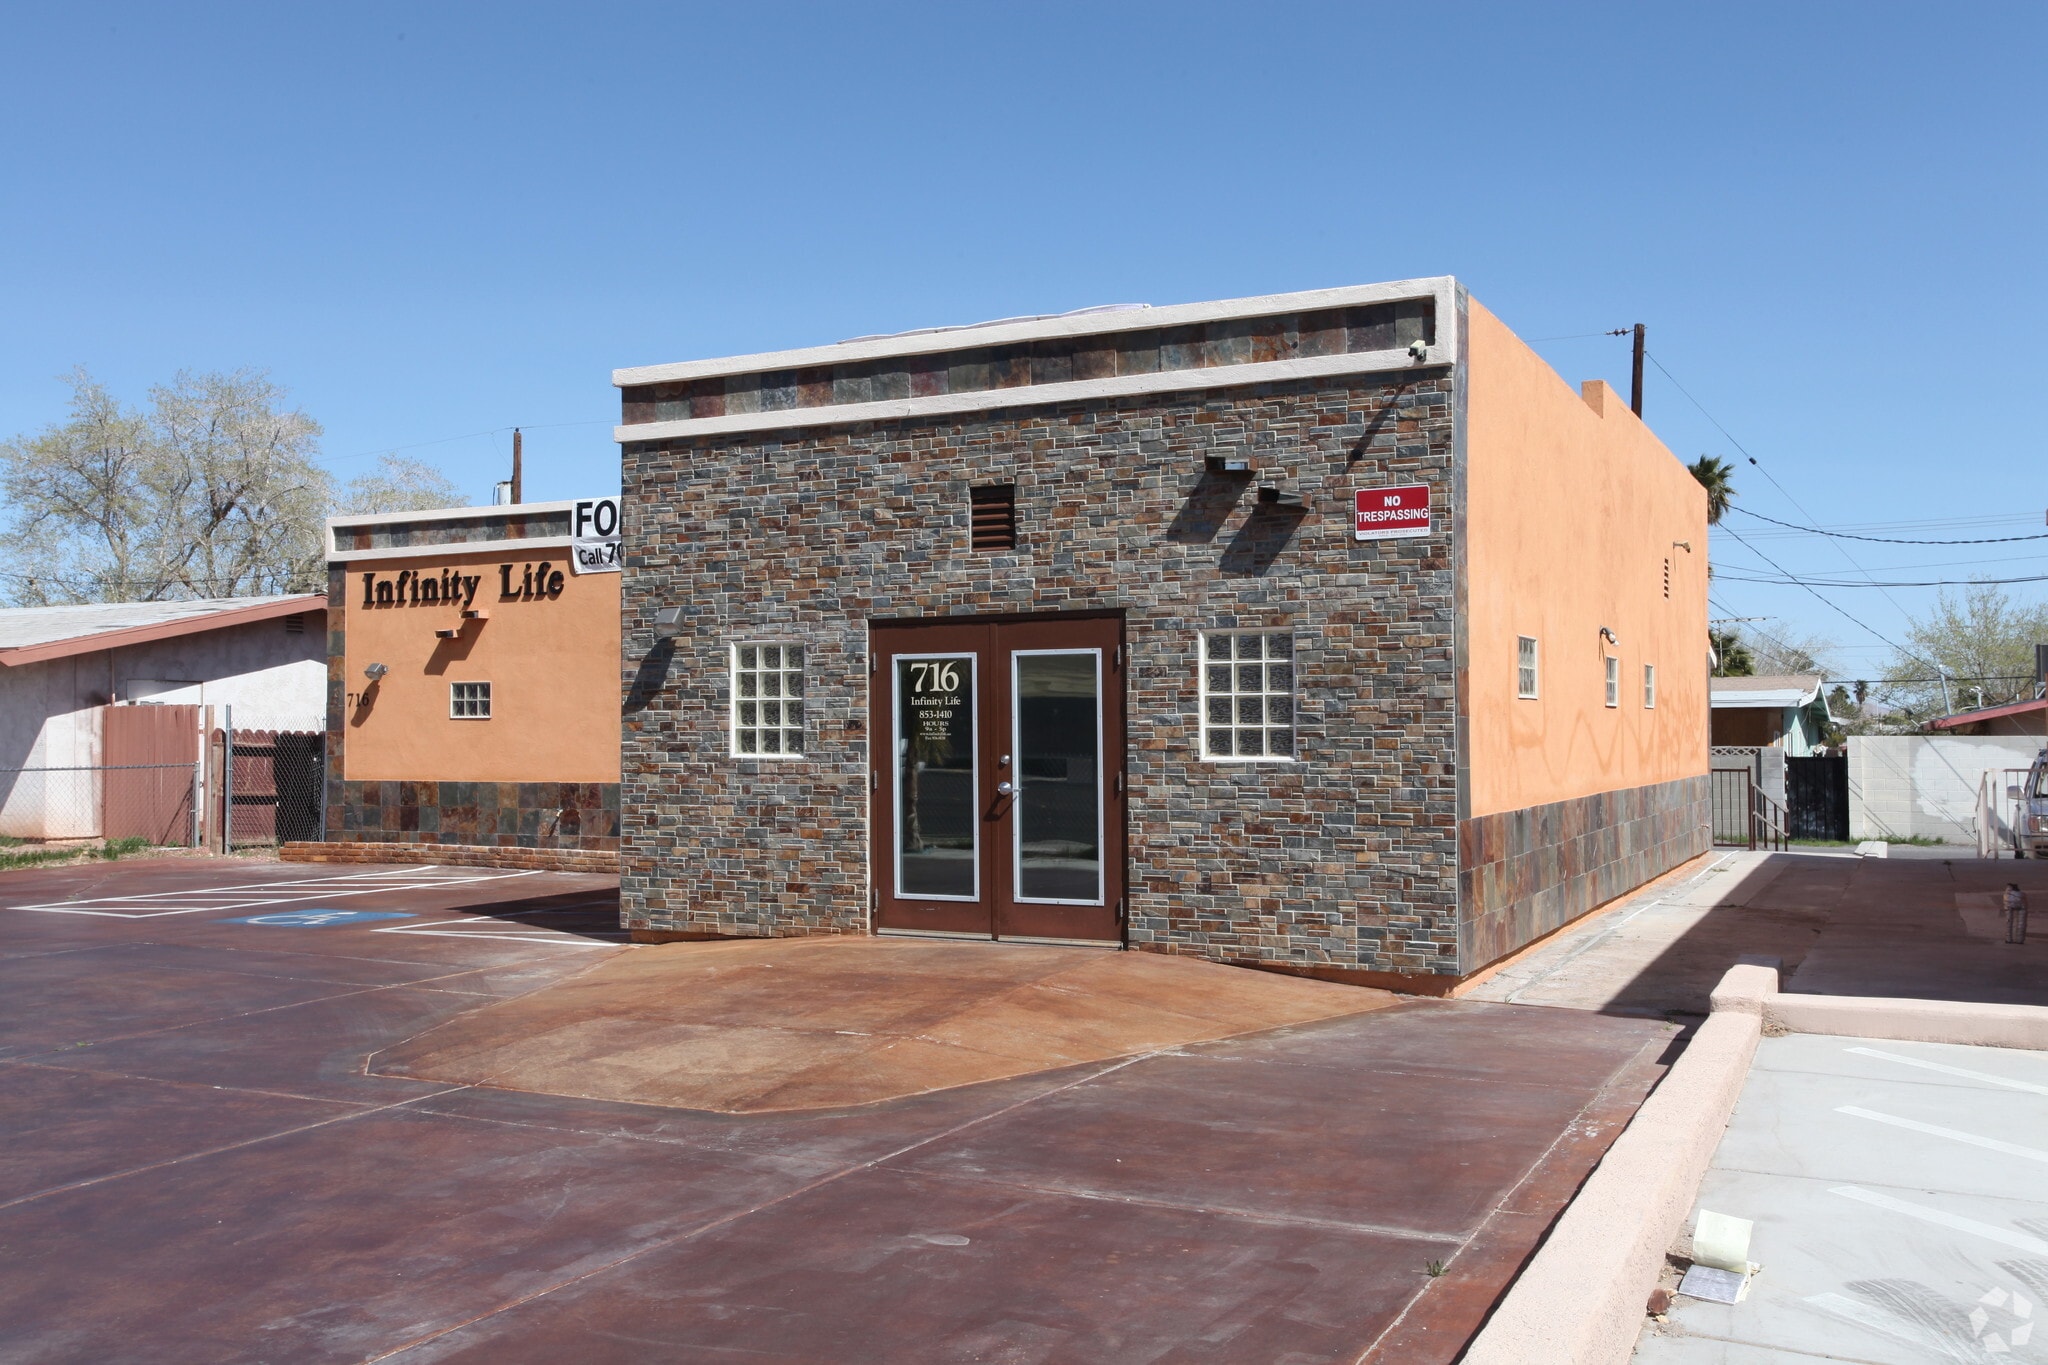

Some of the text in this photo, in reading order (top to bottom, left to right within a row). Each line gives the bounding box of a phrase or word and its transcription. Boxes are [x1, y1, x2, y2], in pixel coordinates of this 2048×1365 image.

[1384, 495, 1401, 507] NO
[576, 500, 622, 538] FO
[1357, 508, 1429, 523] TRESPASSING
[579, 548, 603, 566] Call
[363, 562, 565, 606] Infinity Life
[910, 661, 960, 692] 716
[347, 693, 370, 708] 716
[911, 696, 961, 707] Infinity Life
[919, 711, 952, 719] 853-1410
